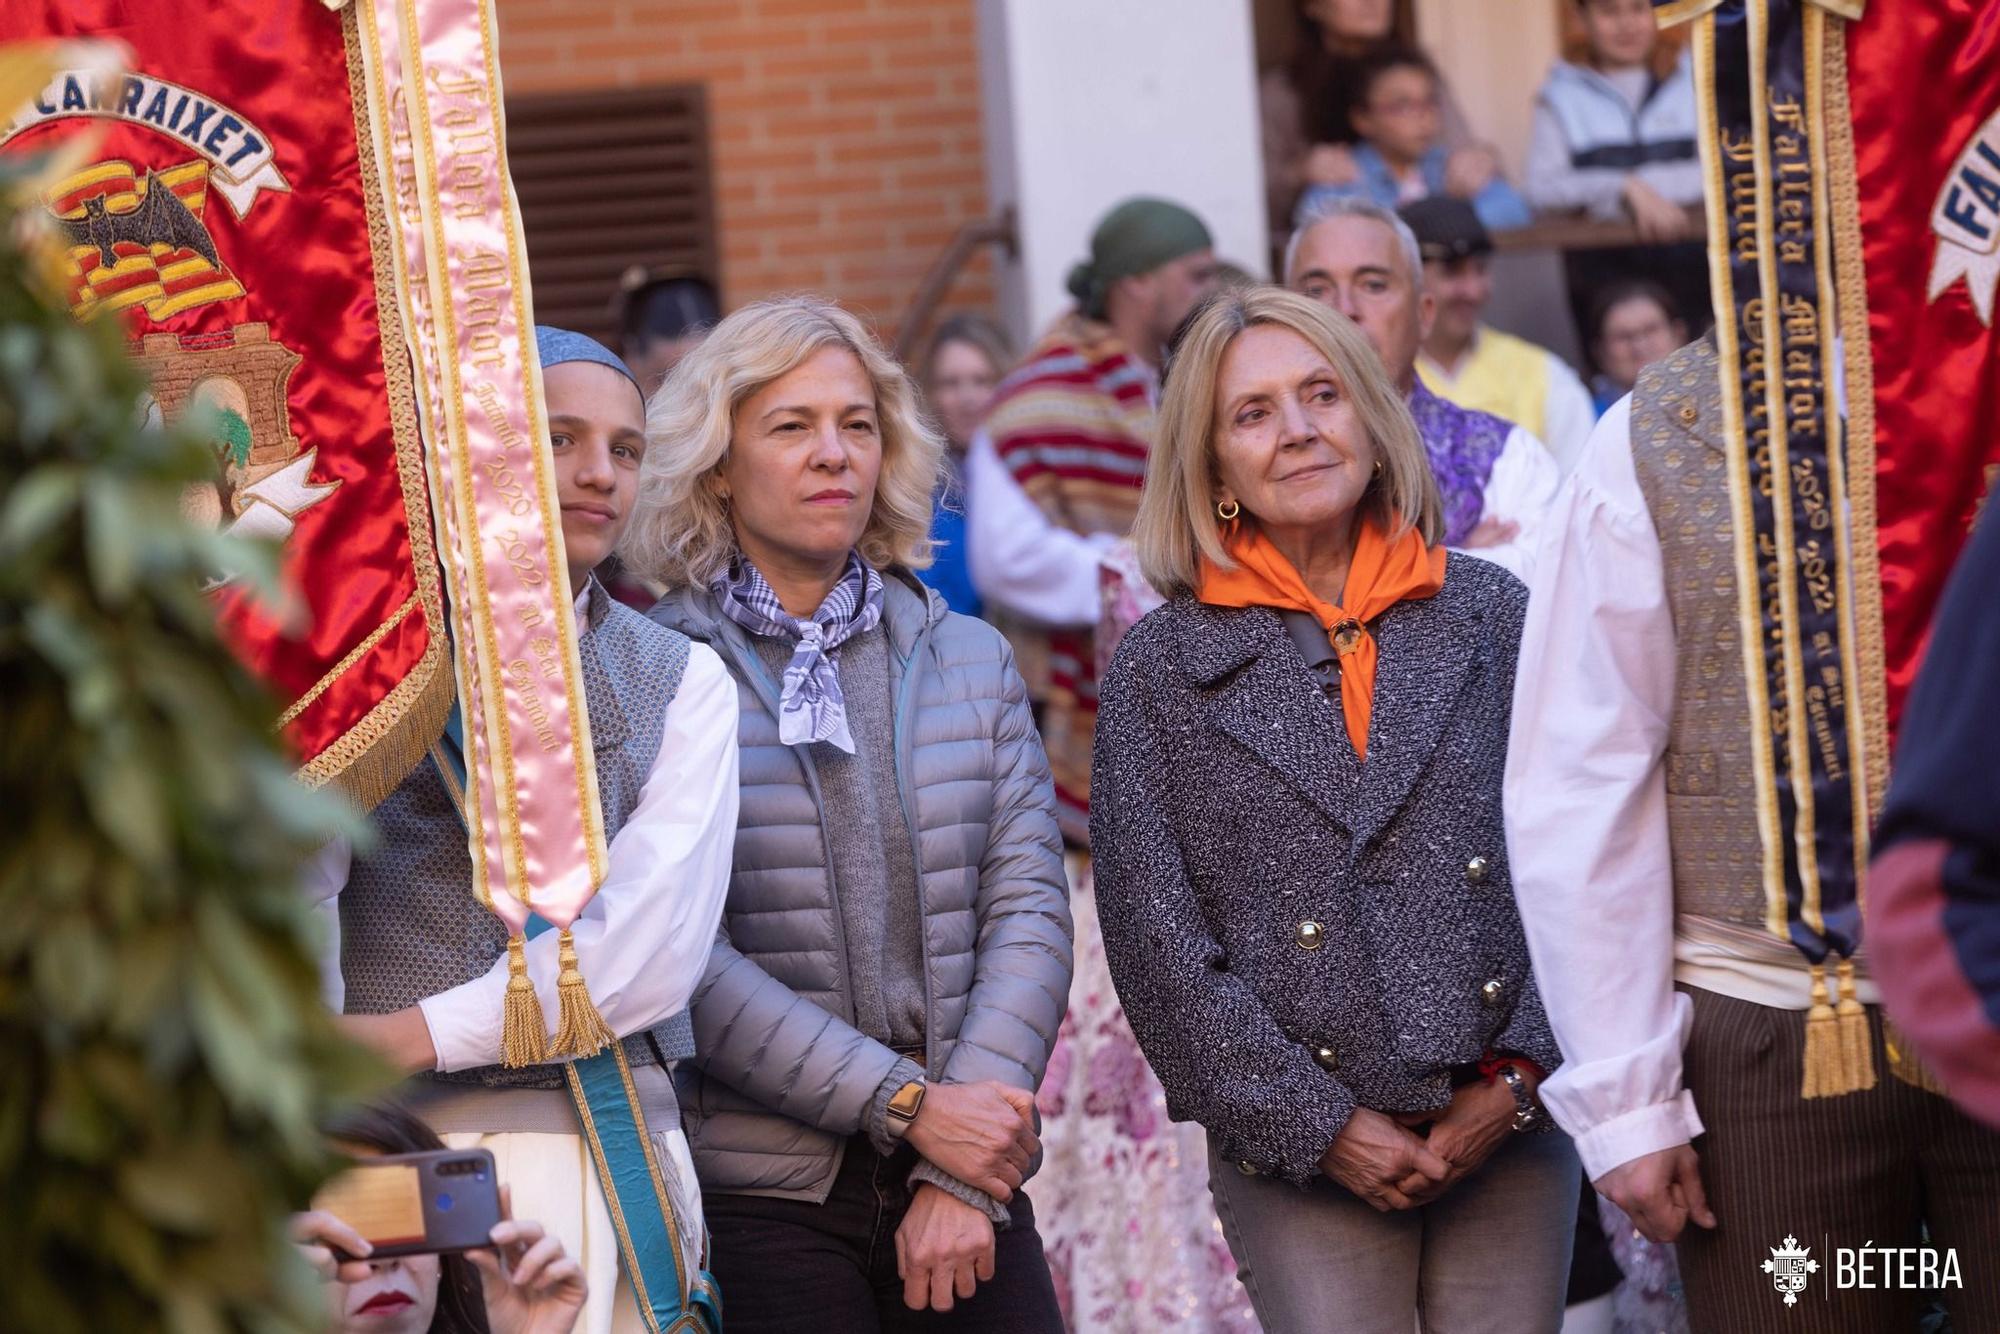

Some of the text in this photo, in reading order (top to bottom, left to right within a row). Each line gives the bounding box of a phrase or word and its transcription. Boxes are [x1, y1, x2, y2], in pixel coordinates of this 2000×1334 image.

[429, 67, 491, 220] Fallera
[1767, 85, 1809, 263] Fallera
[455, 244, 508, 368] Major
[1781, 292, 1823, 435] Major
[471, 382, 525, 449] Infantil
[482, 455, 531, 516] 2020
[1791, 457, 1829, 531] 2020
[494, 530, 543, 592] 2022
[1797, 539, 1835, 615] 2022
